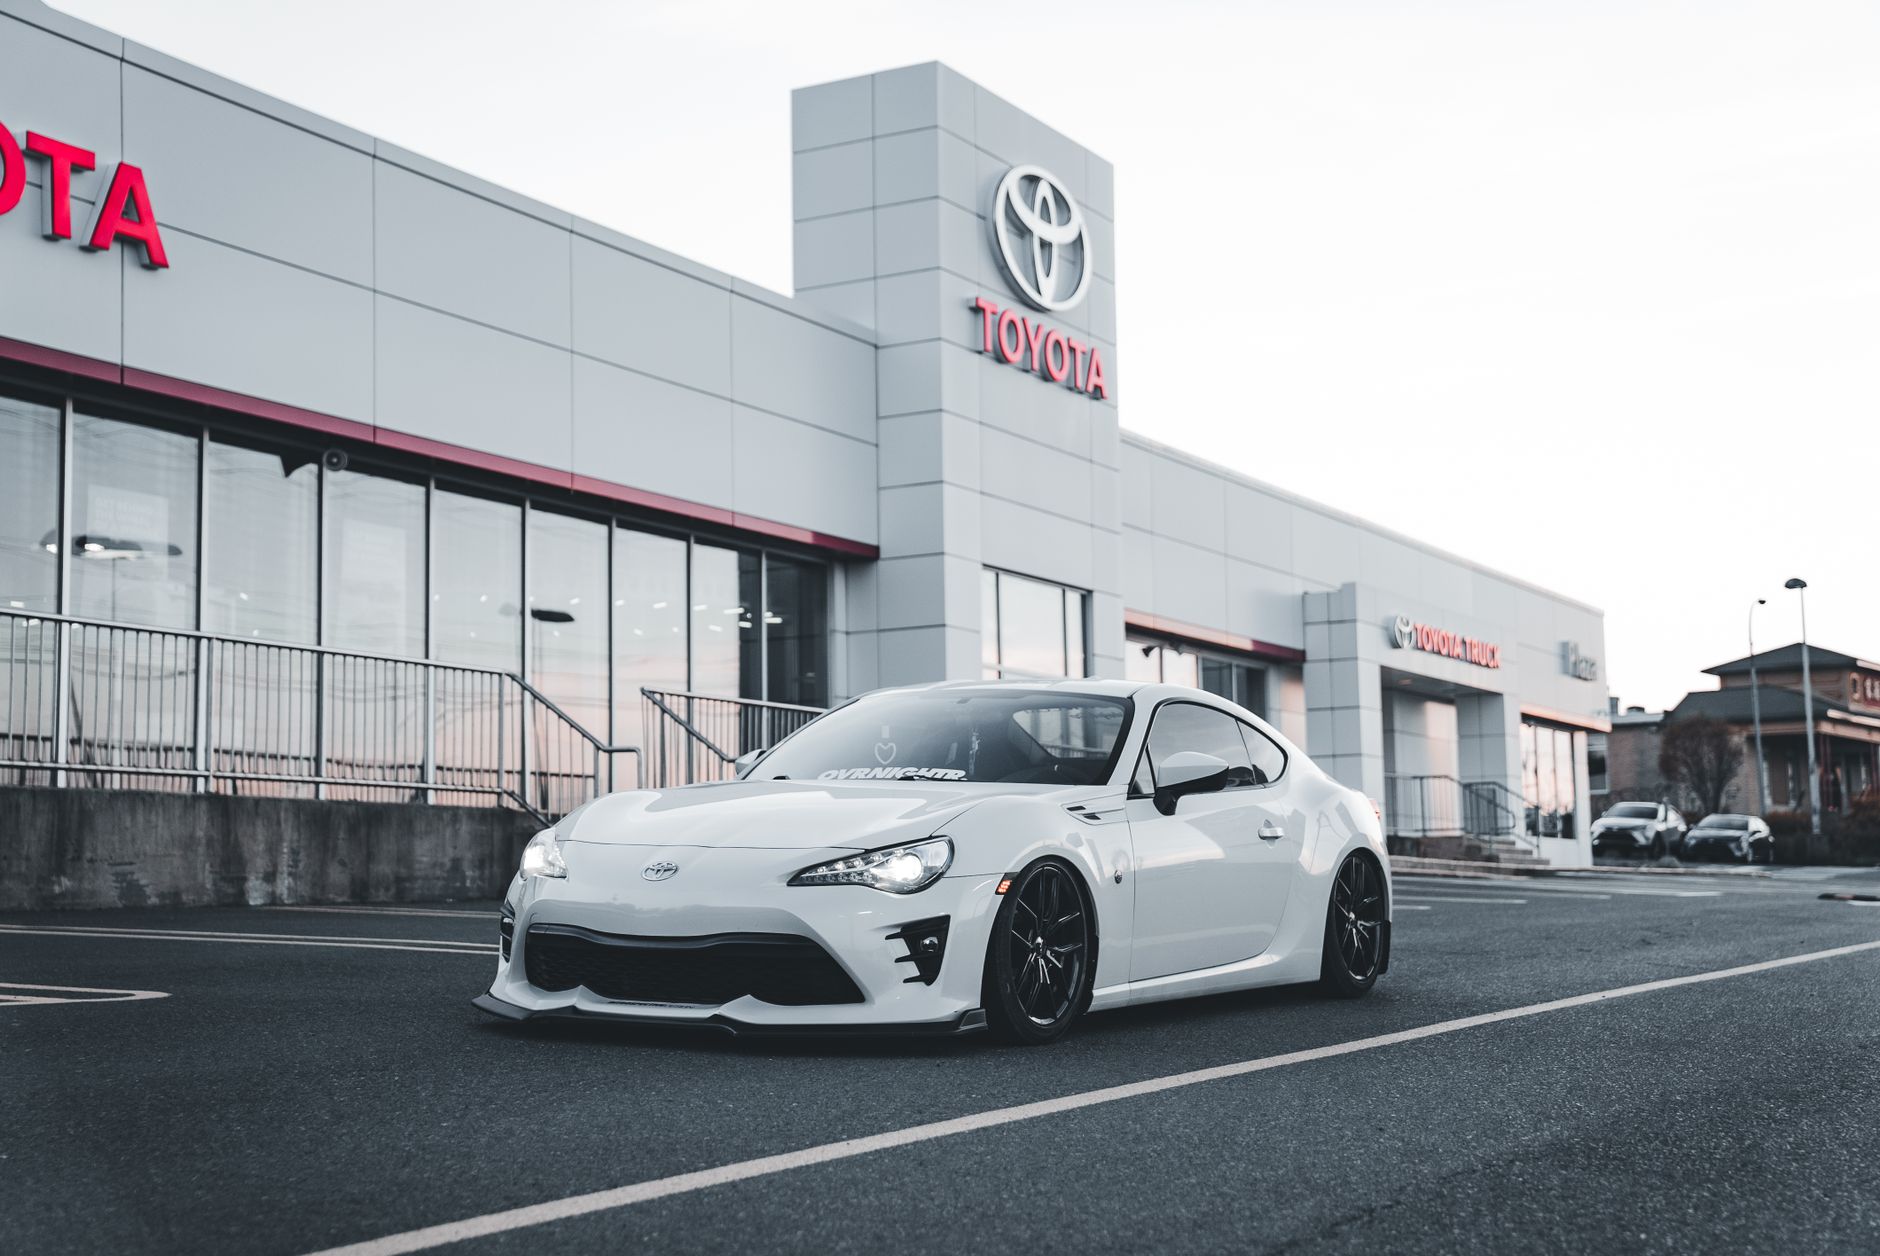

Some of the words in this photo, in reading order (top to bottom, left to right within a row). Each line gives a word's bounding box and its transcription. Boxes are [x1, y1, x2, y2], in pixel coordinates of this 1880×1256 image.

[976, 297, 1107, 400] TOYOTA
[1414, 624, 1462, 658] TOYOTA
[1464, 638, 1500, 668] TRUCK
